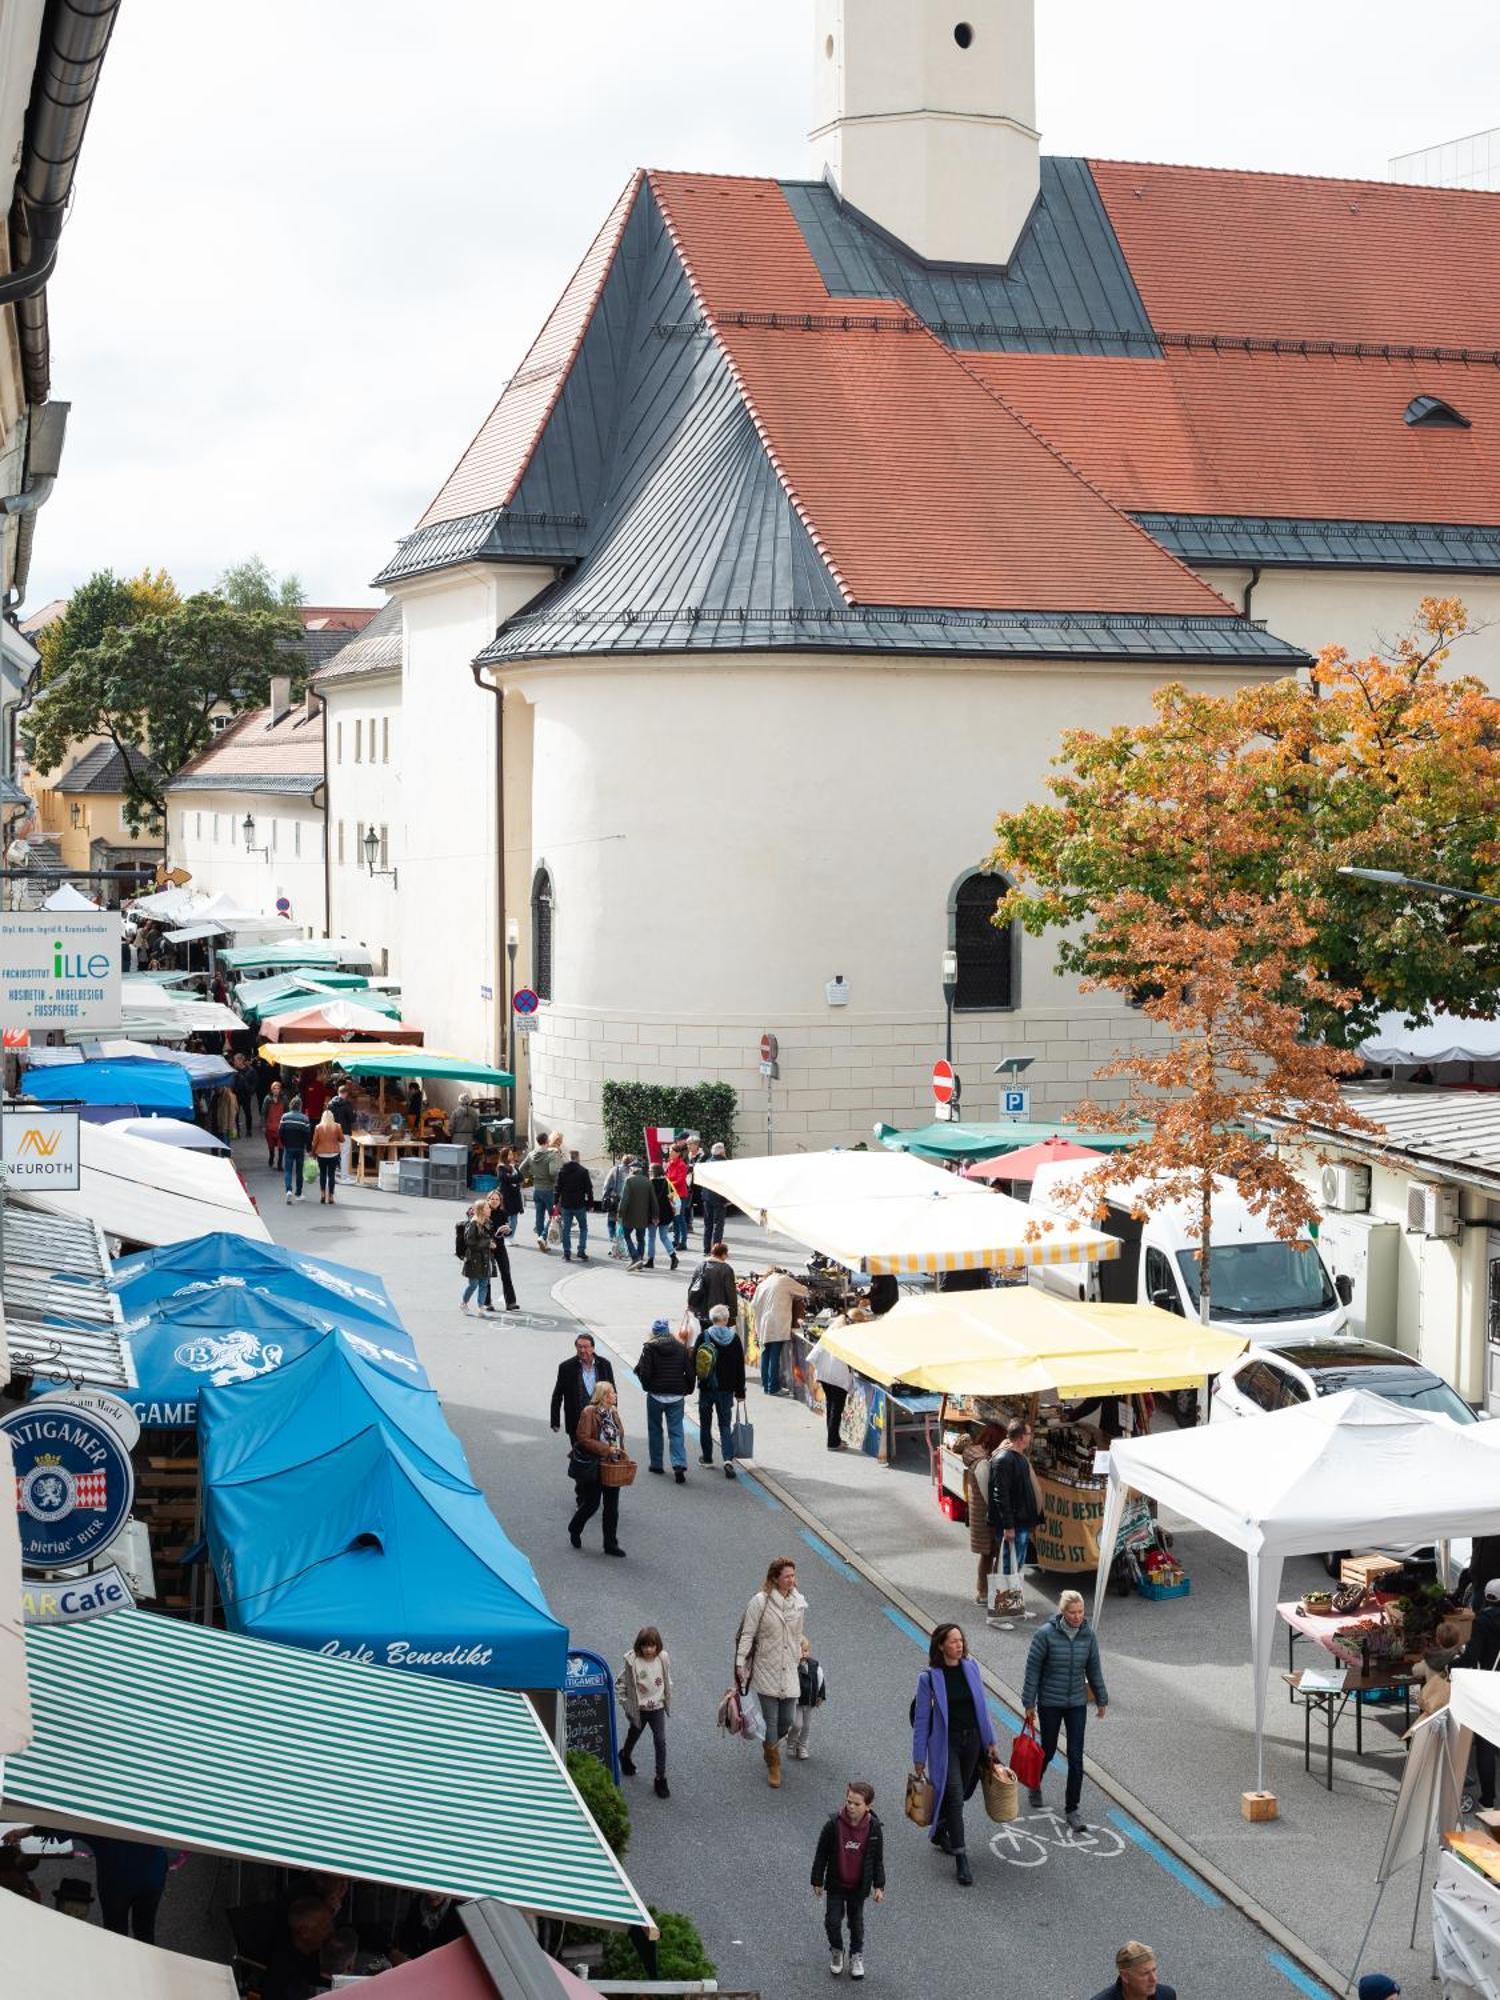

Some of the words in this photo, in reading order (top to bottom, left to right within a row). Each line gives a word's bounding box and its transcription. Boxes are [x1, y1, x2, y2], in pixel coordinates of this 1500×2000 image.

[9, 988, 45, 1001] KOSMETIK
[55, 988, 104, 1001] NAGELDESIGN
[34, 1004, 79, 1017] FUSSPFLEGE
[1009, 1094, 1020, 1110] P
[7, 1163, 73, 1174] NEUROTH
[97, 1399, 123, 1420] Markt
[133, 1403, 197, 1424] GAME
[9, 1421, 108, 1465] NTIGAMER
[77, 1518, 105, 1545] BIER
[386, 1640, 493, 1667] Benedikt
[564, 1676, 601, 1688] TIGAMER
